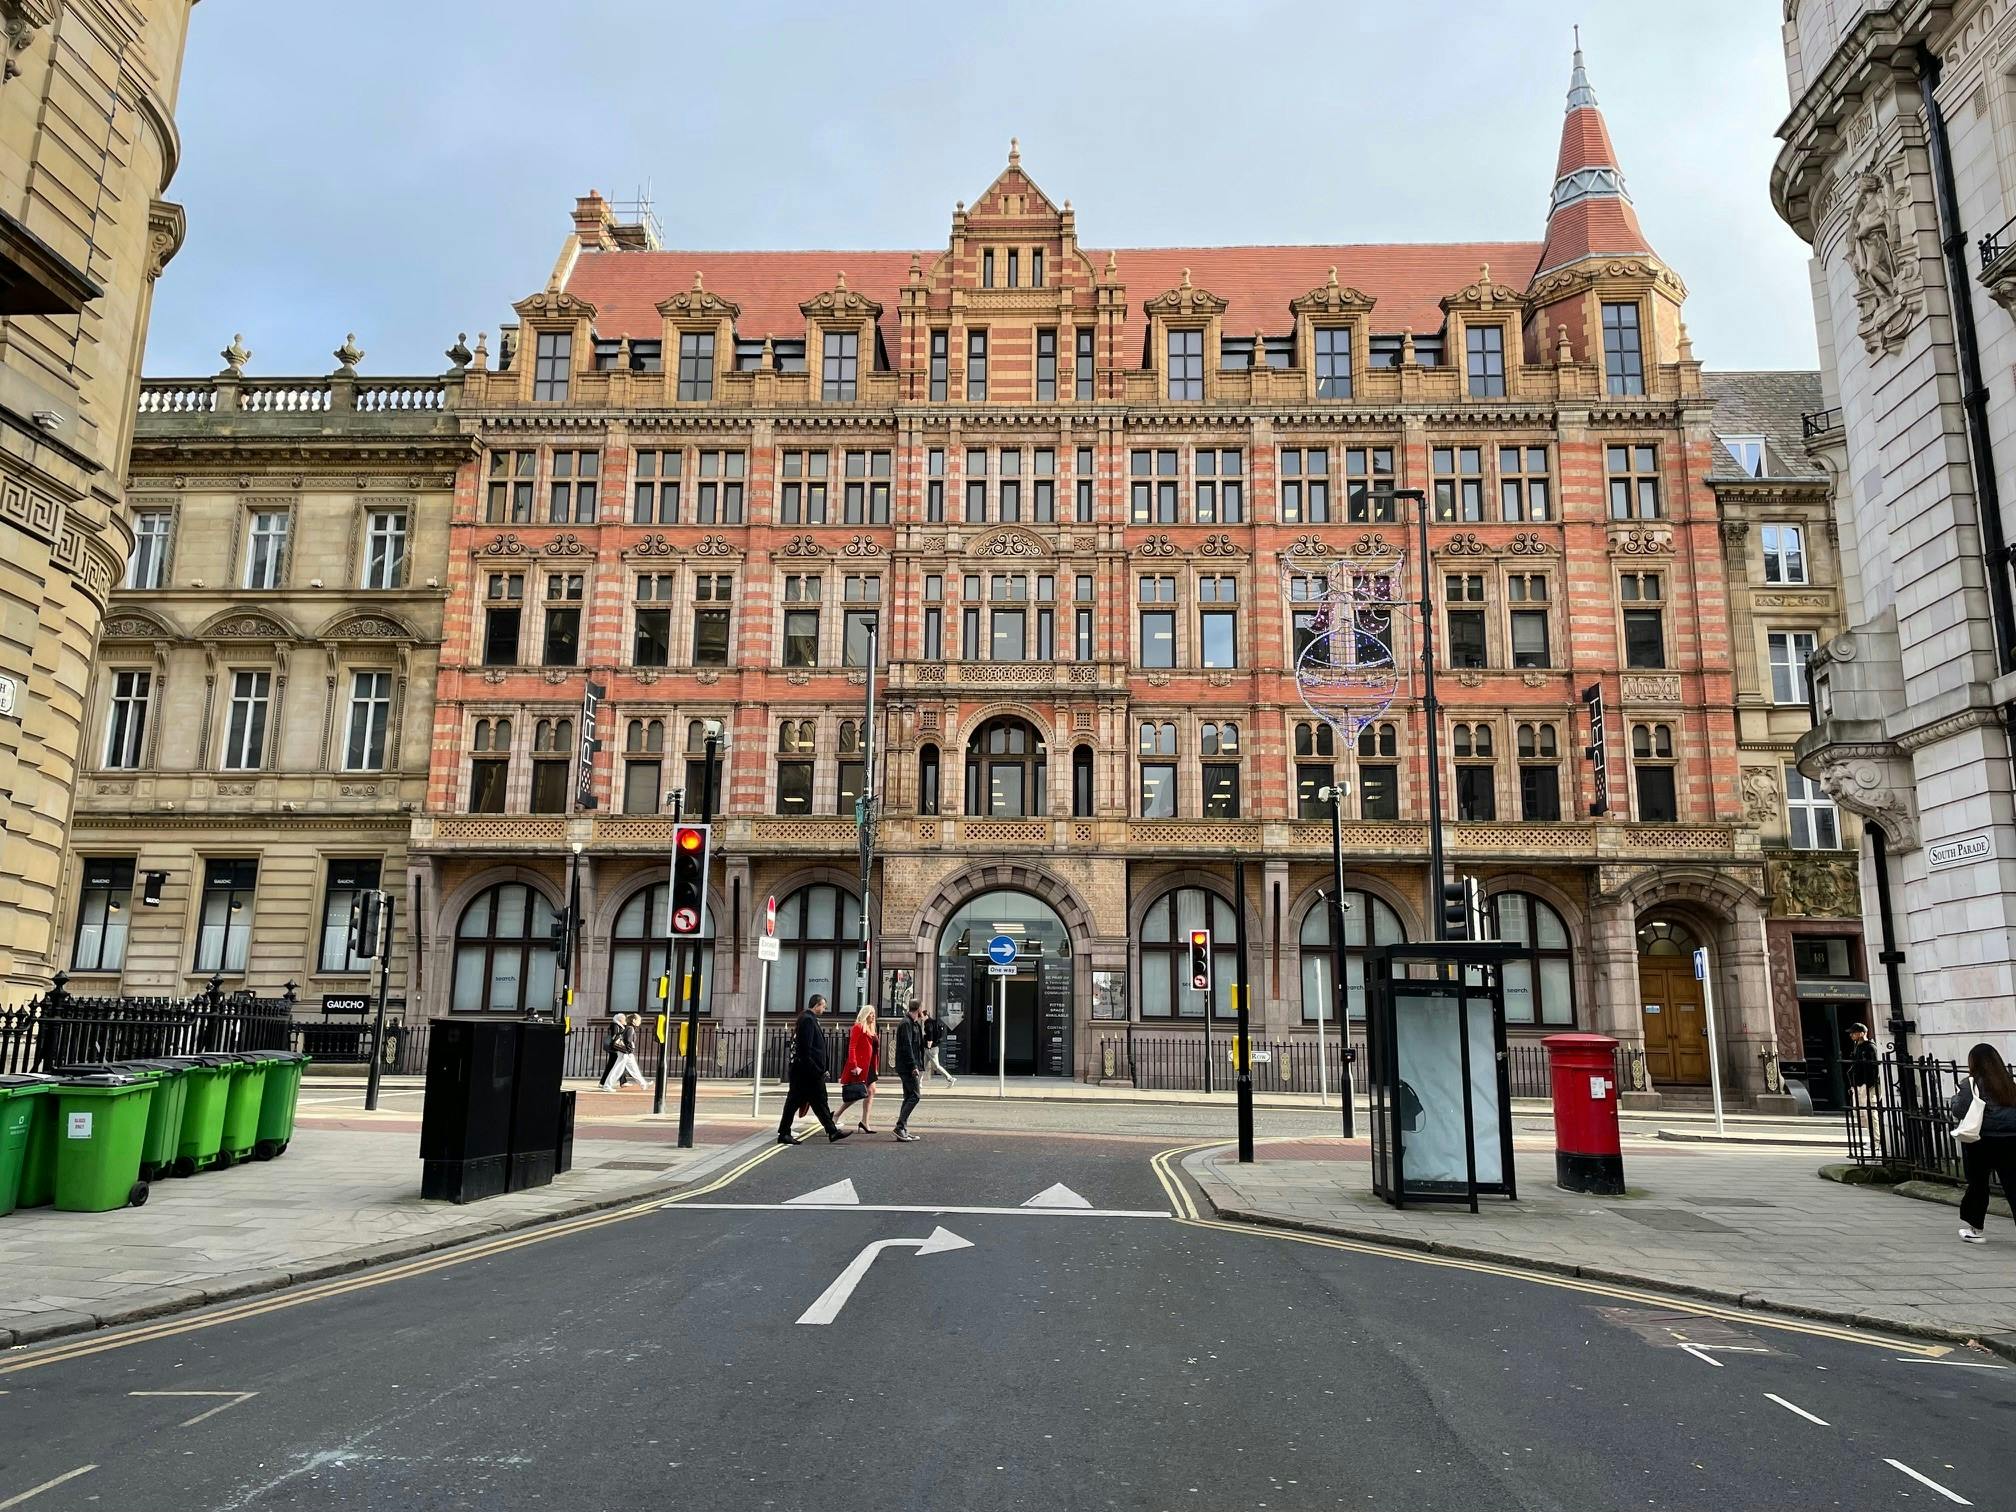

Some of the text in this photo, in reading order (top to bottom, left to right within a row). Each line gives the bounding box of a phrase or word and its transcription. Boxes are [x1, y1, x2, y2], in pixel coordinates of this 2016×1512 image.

[583, 693, 597, 765] PRH
[1590, 697, 1604, 771] PRH
[1932, 842, 1986, 861] SOUTH PARADE
[326, 1001, 364, 1009] GAUCHO
